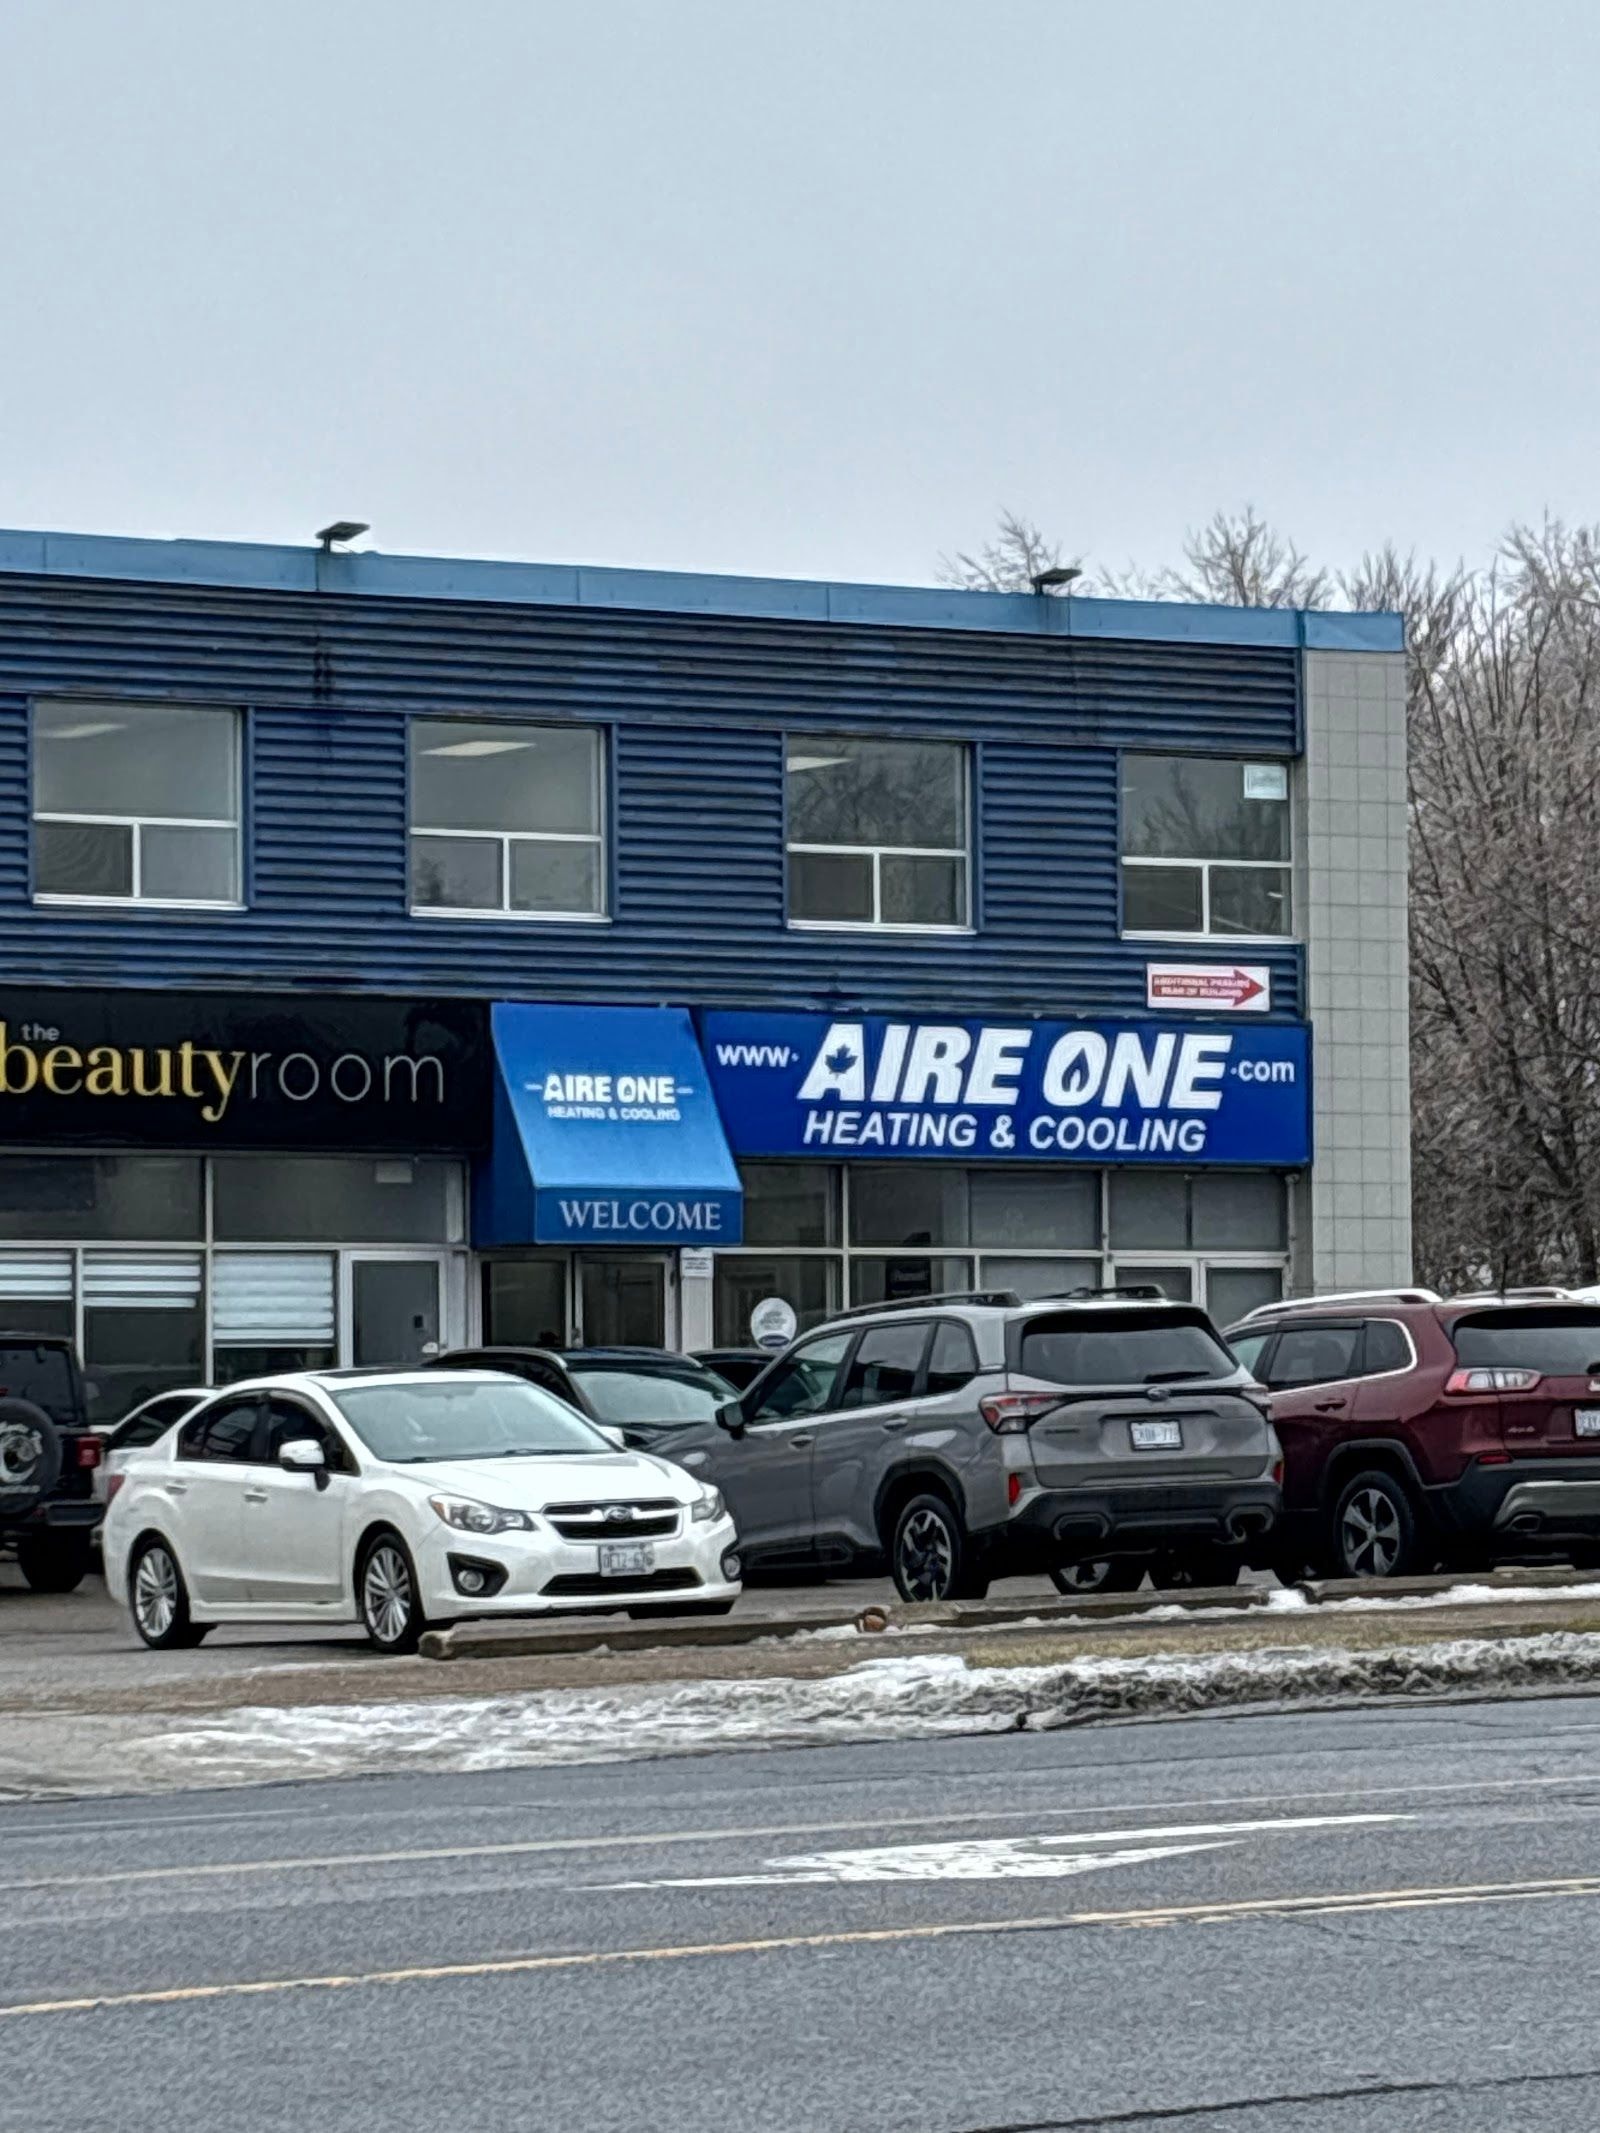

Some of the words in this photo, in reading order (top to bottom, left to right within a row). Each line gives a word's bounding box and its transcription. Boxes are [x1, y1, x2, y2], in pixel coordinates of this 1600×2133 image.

[21, 1023, 60, 1042] the
[796, 1023, 1033, 1106] AIRE
[1042, 1030, 1233, 1111] ONE
[543, 1073, 613, 1103] AIRE
[616, 1075, 676, 1105] ONE
[547, 1105, 606, 1120] HEATING
[608, 1107, 619, 1121] &
[620, 1107, 682, 1122] COOLING
[802, 1110, 979, 1149] HEATING
[989, 1114, 1016, 1149] &
[1028, 1115, 1208, 1153] COOLING
[558, 1200, 723, 1231] WELCOME
